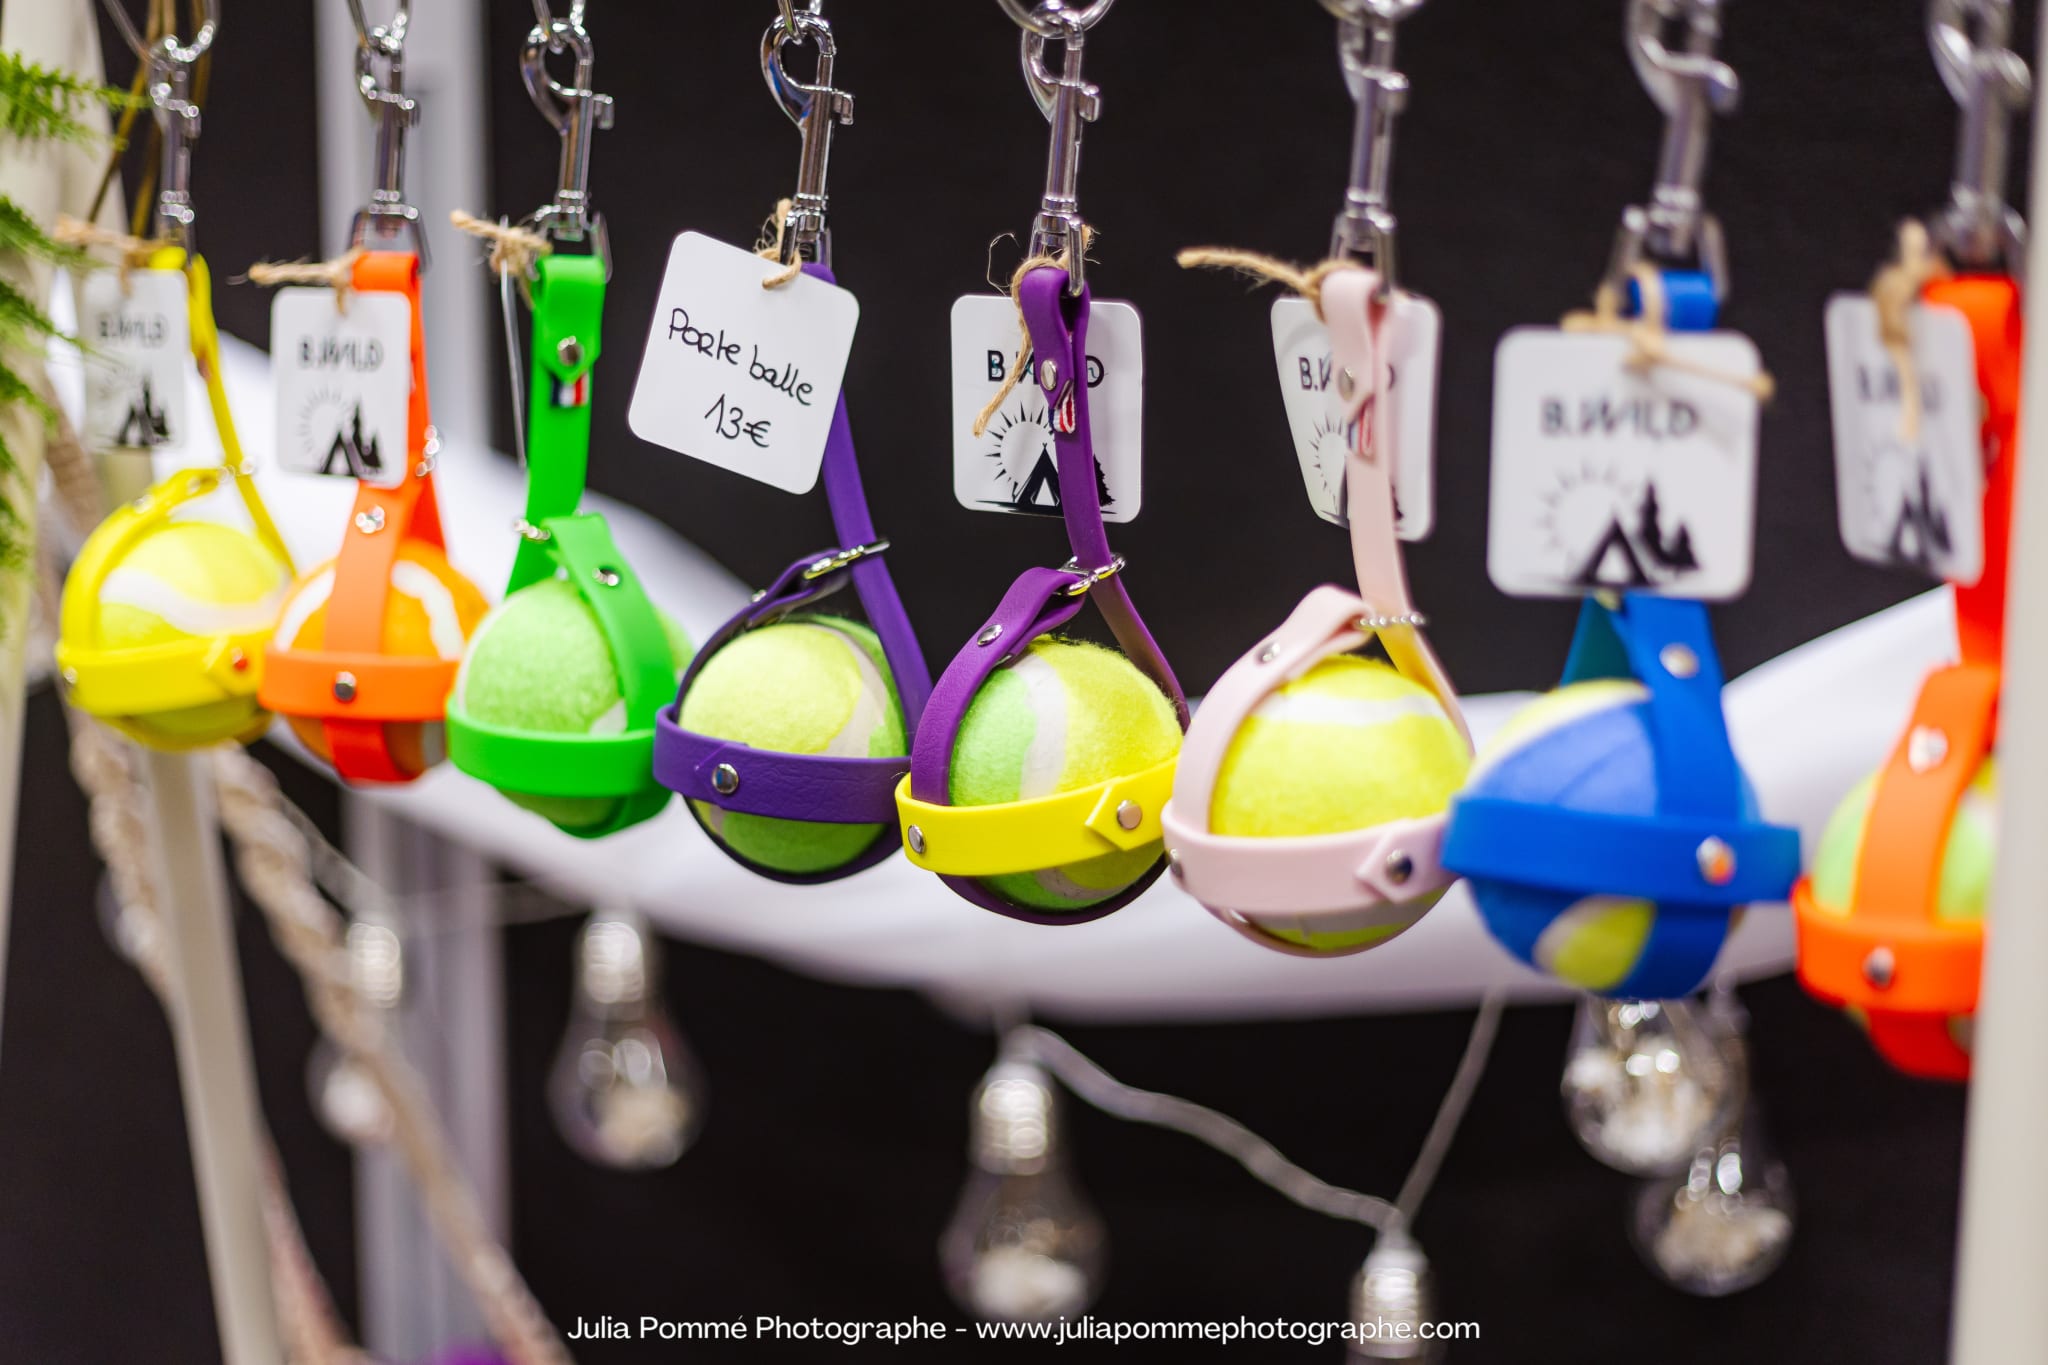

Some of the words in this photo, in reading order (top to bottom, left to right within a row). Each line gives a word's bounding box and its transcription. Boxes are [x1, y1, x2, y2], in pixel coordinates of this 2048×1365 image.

[749, 344, 813, 406] balle
[704, 393, 771, 448] 13€
[1541, 395, 1700, 437] B.WILD
